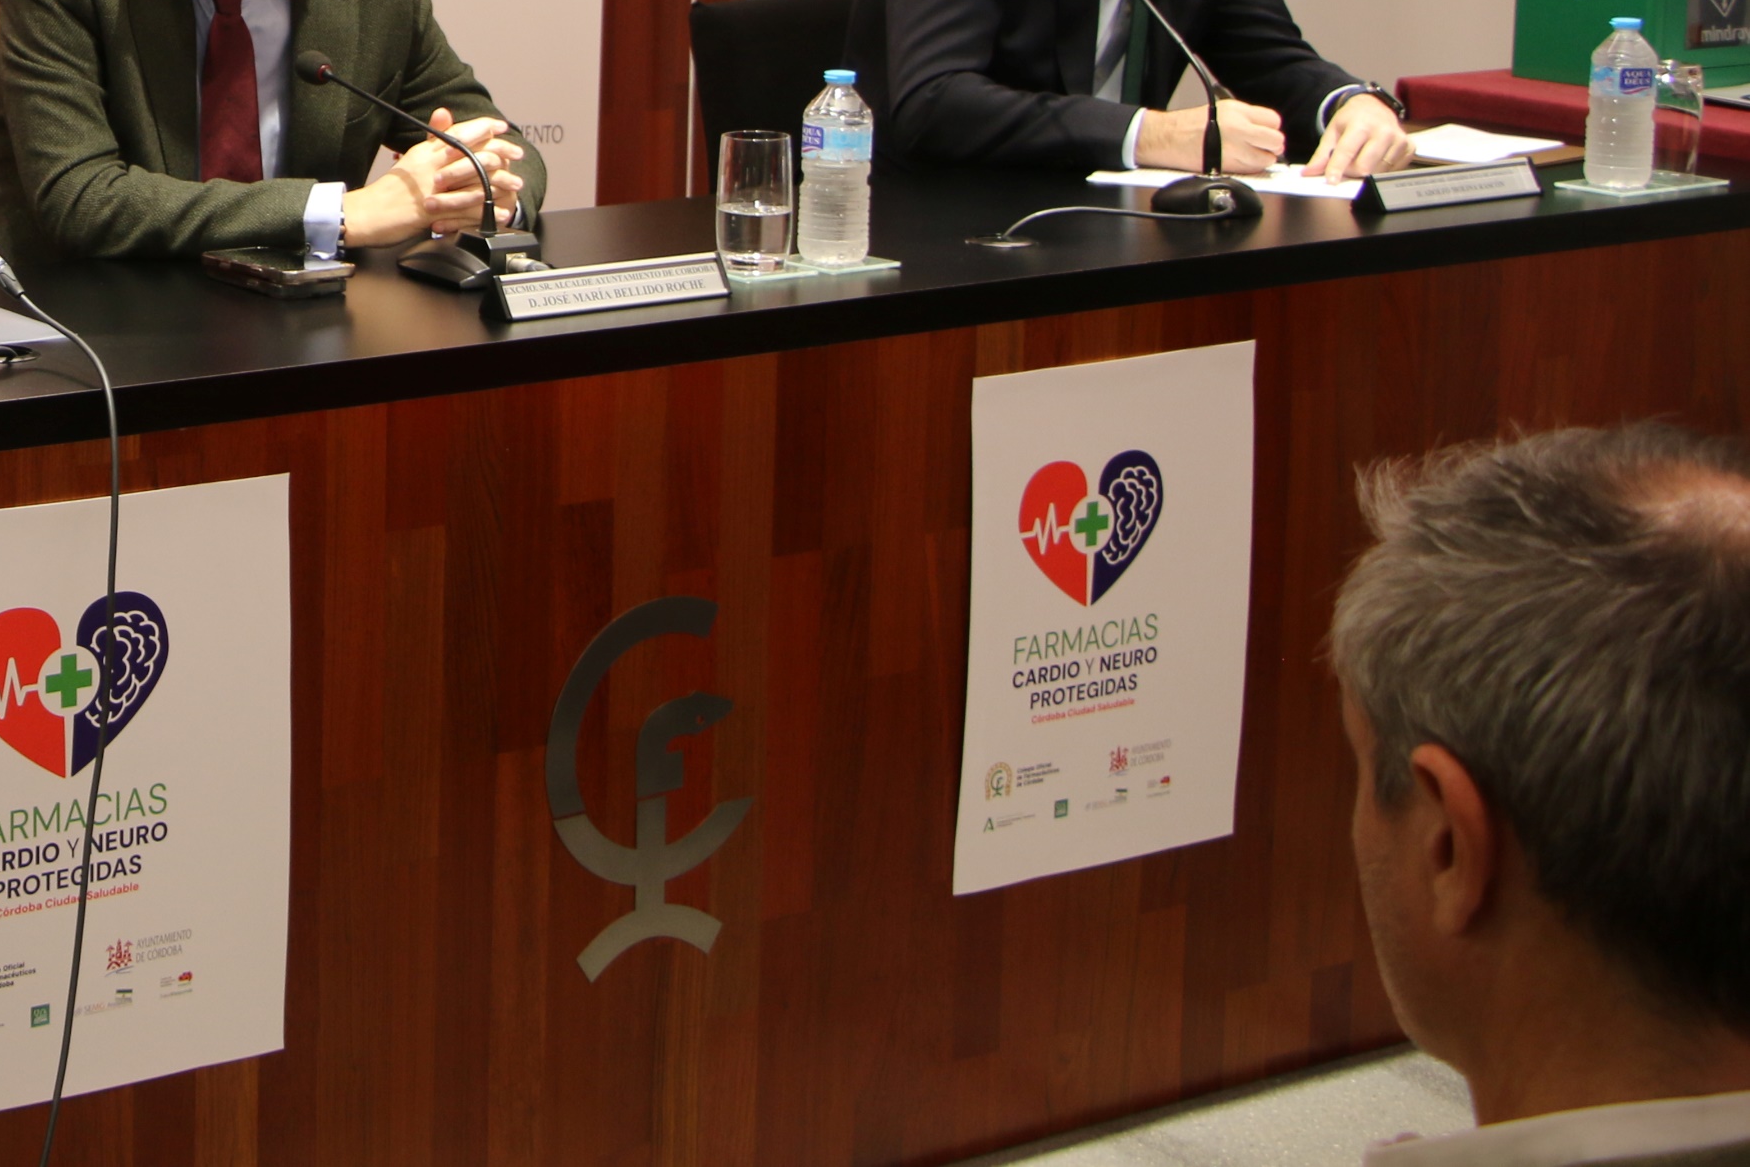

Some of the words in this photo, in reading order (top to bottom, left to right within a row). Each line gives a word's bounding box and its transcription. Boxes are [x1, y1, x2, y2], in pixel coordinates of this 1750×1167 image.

[554, 278, 594, 289] ALCALDE
[595, 270, 661, 284] AYUNTAMIENTO
[662, 269, 673, 277] DE
[528, 298, 541, 309] D.
[542, 291, 571, 307] JOSÉ
[572, 287, 612, 303] MARÍA
[613, 283, 664, 299] BELLIDO
[665, 278, 706, 293] ROCHE
[1013, 612, 1159, 665] FARMACIAS
[1012, 660, 1081, 689] CARDIO
[1085, 658, 1095, 675] Y
[1099, 646, 1158, 674] NEURO
[1030, 673, 1138, 710] PROTEGIDAS
[1031, 711, 1066, 725] Córdoba
[1067, 706, 1096, 718] Ciudad
[1097, 697, 1135, 712] Saludable
[66, 837, 79, 858] Y
[90, 821, 169, 854] NEURO
[85, 882, 140, 901] Saludable
[136, 928, 193, 949] AYUNTAMIENTO
[3, 961, 25, 972] Oficial
[136, 953, 145, 964] DE
